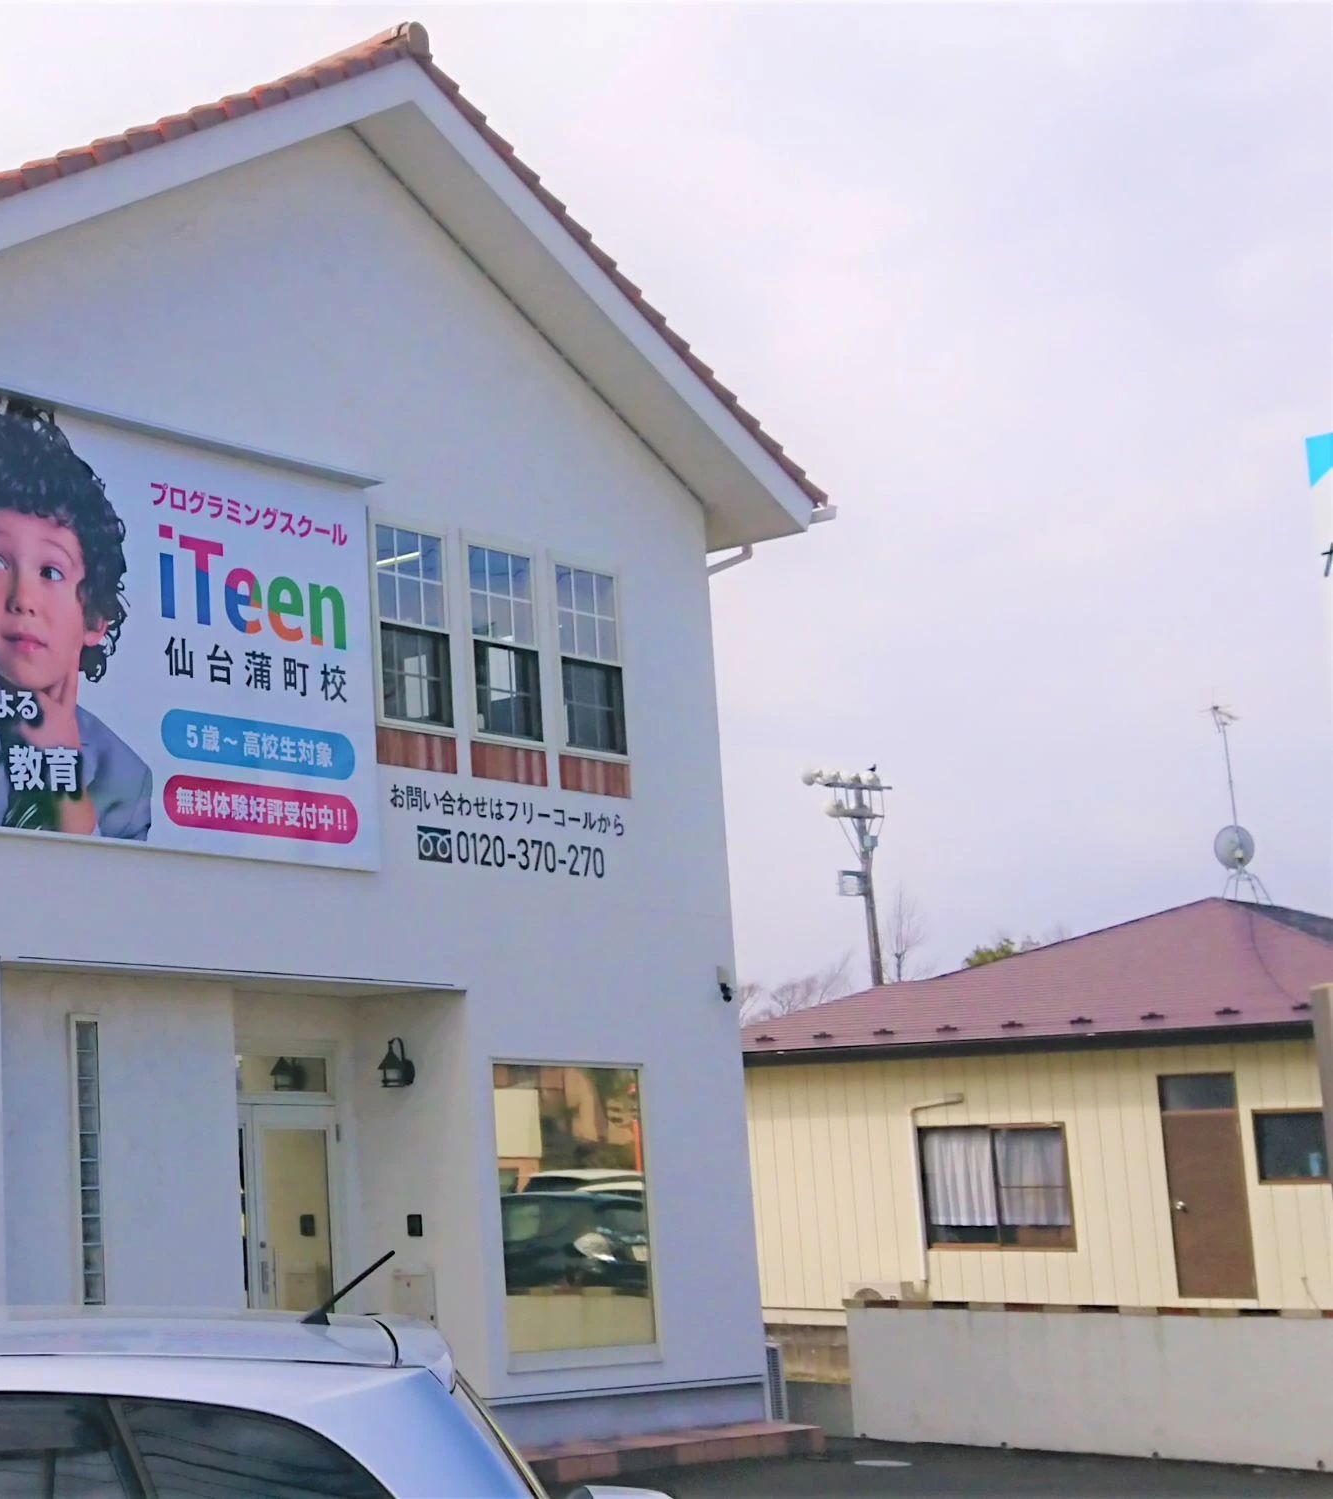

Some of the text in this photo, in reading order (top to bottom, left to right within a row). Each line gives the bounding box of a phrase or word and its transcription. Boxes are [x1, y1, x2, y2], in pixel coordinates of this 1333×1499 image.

[150, 482, 348, 546] プログラミングスクール
[158, 524, 347, 650] iTeen
[164, 636, 348, 703] 仙台蒲町校
[390, 784, 625, 836] お問い合わせはフリーコールから
[457, 831, 605, 879] 0120-370-270
